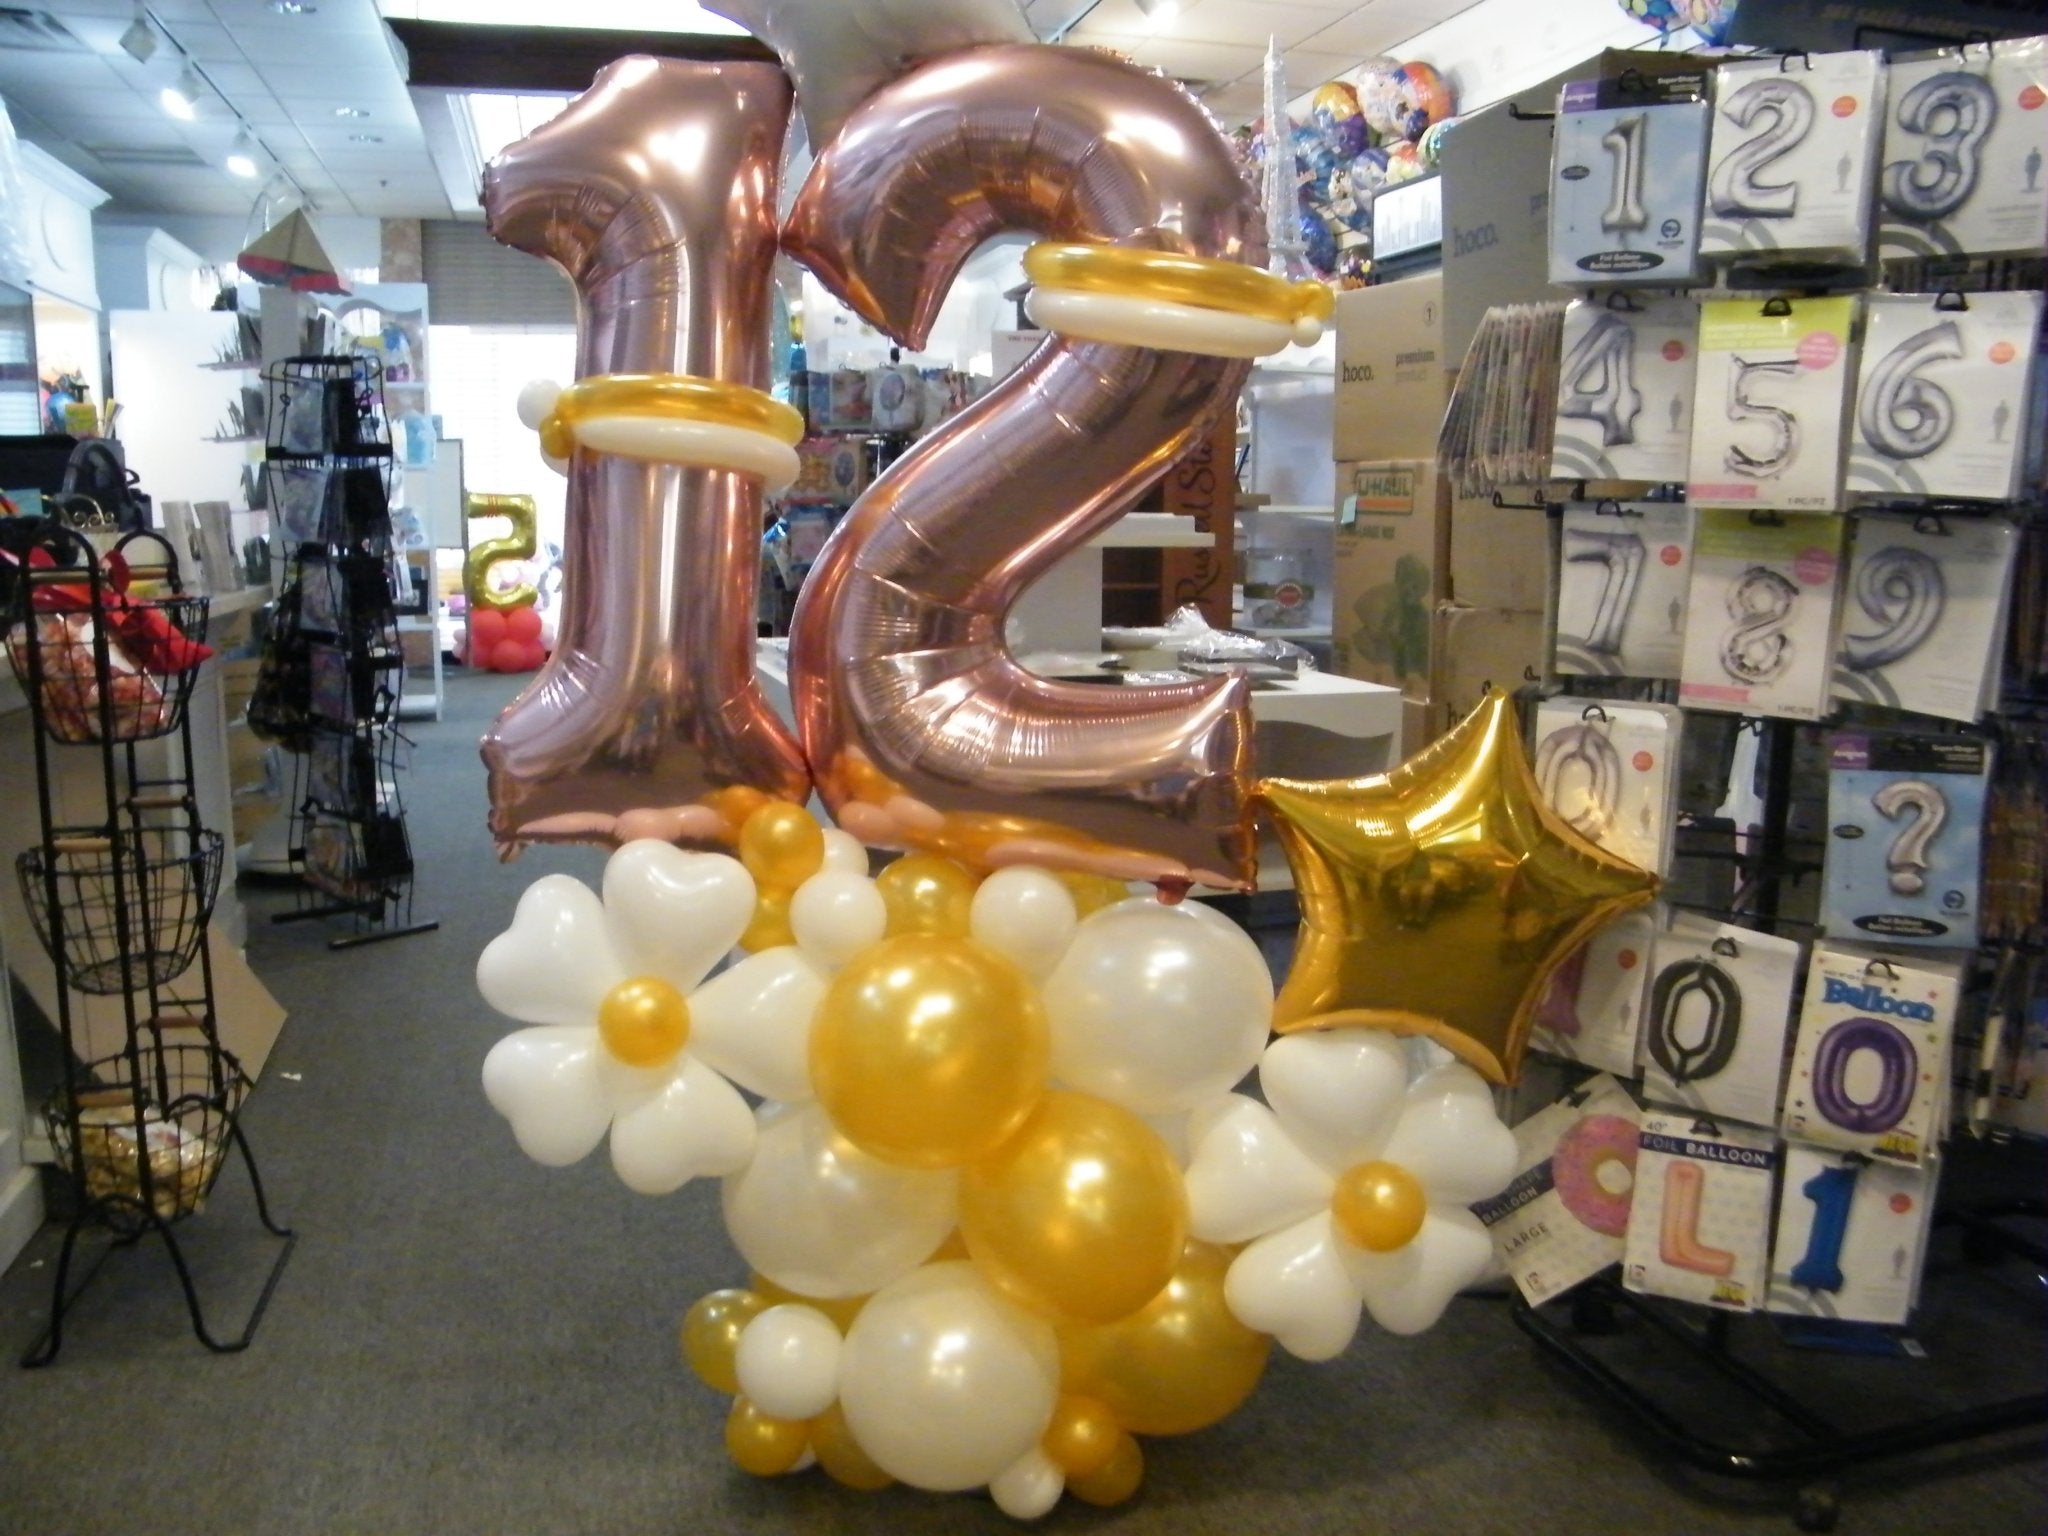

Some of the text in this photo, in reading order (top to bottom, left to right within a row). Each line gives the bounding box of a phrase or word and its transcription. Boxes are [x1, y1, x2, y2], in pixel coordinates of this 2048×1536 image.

[1601, 112, 1649, 234] 1
[1709, 77, 1816, 218] 2
[1342, 361, 1375, 383] hoco.
[1558, 313, 1642, 447] 4
[1724, 353, 1800, 480] 5
[1858, 320, 1964, 460] 6
[1357, 476, 1411, 497] U-HAUL
[1566, 527, 1647, 657] 7
[1719, 565, 1800, 686] 8
[1844, 545, 1948, 673] 9
[1824, 976, 1935, 1023] Balloon
[1481, 1186, 1539, 1225] BALLOON
[1643, 1134, 1767, 1165] FOIL BALLOON
[1502, 1221, 1550, 1252] LARGE
